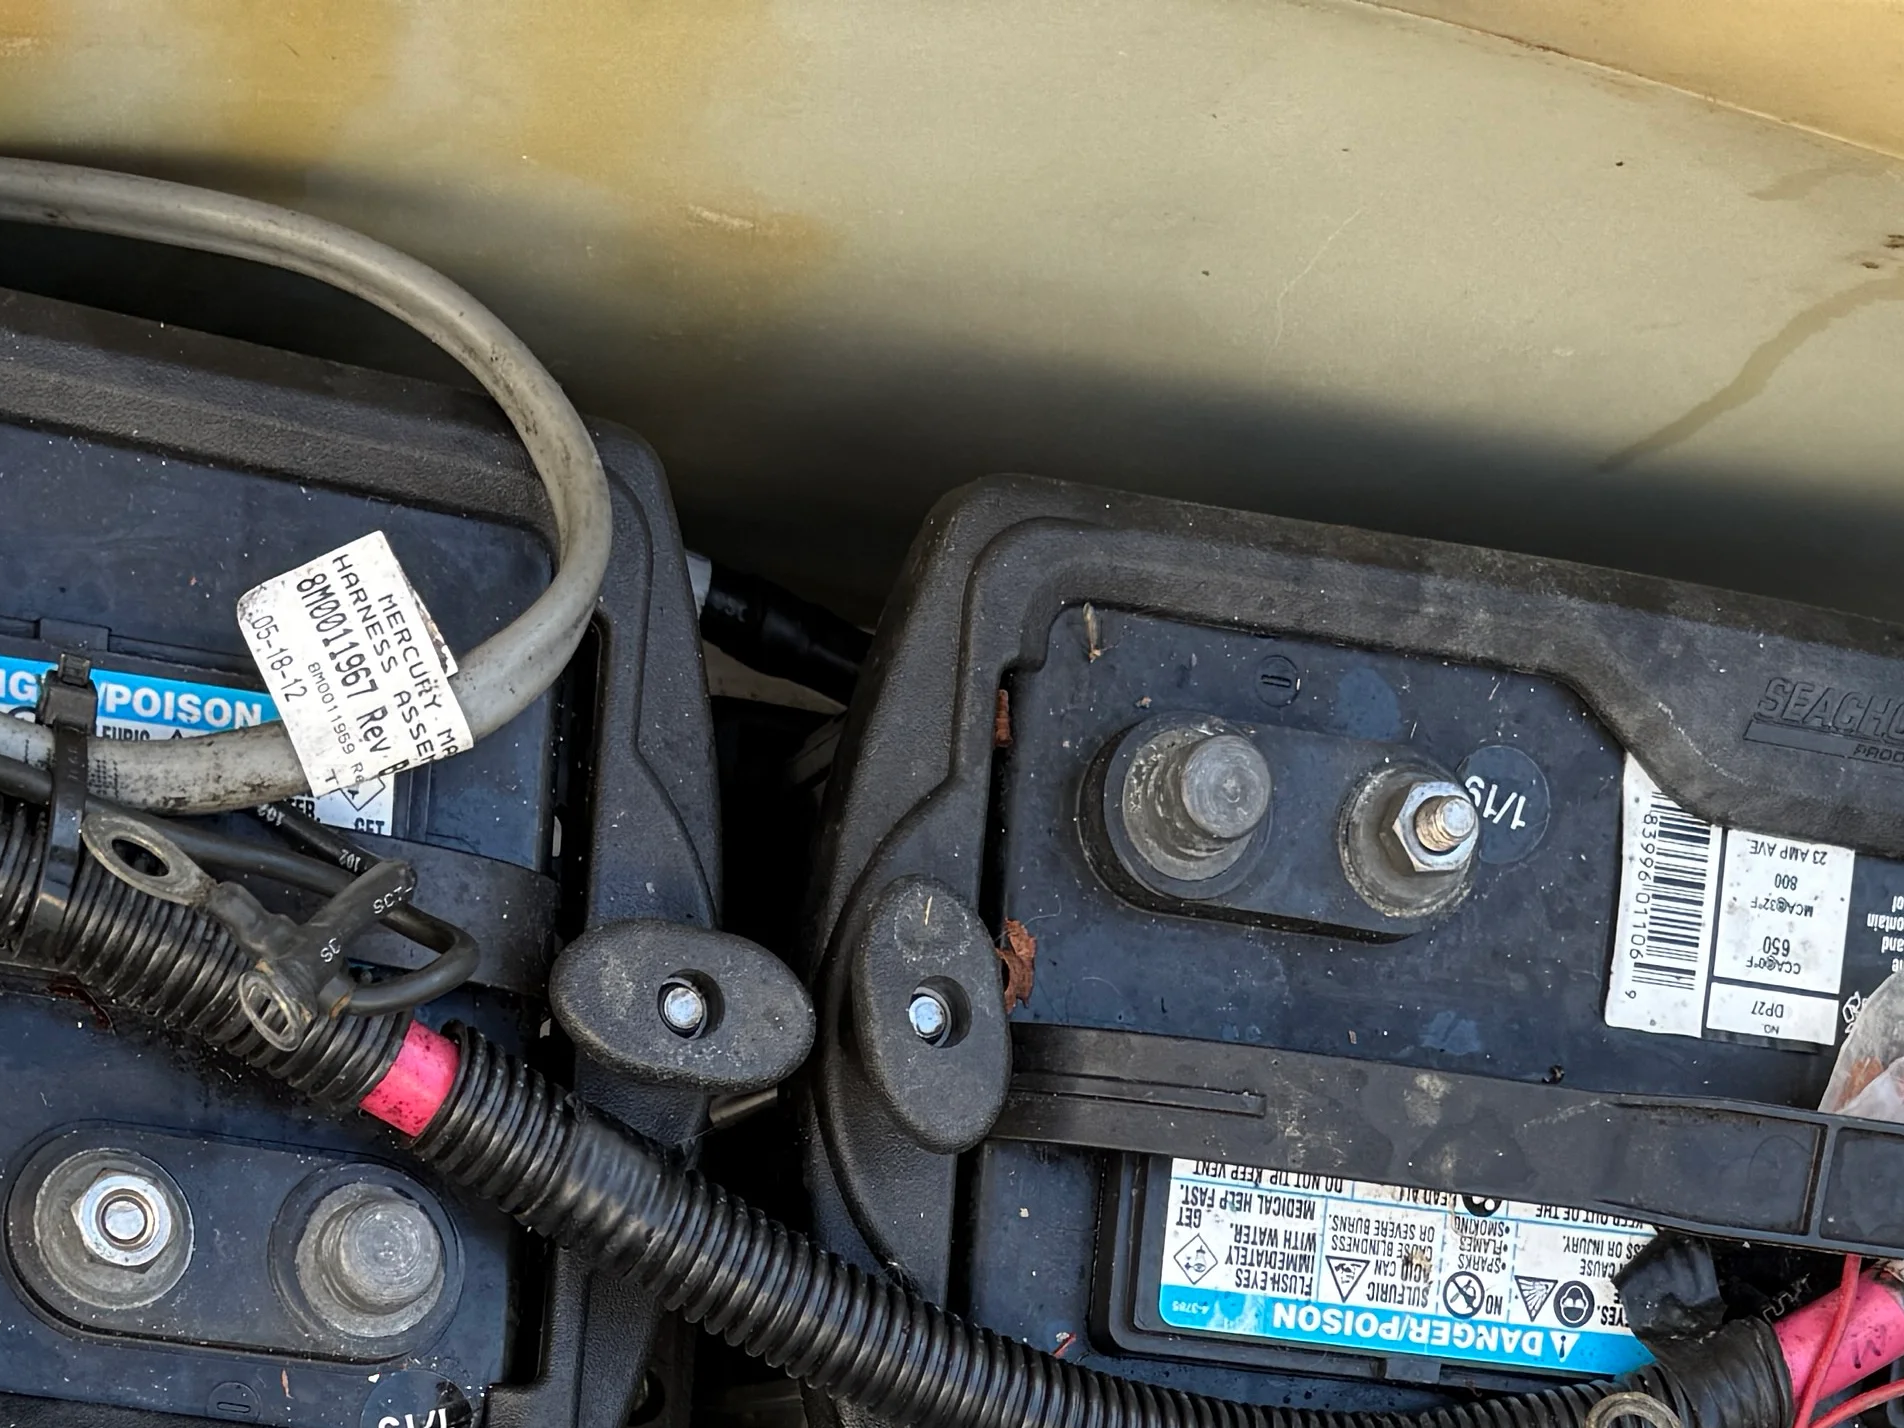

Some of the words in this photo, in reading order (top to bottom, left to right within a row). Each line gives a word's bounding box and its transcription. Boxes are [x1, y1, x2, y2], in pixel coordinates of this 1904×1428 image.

[333, 553, 399, 674] HARNESS
[297, 572, 379, 699] 8M0011967
[252, 614, 308, 703] 05-18-12
[379, 593, 442, 710] MERCURY
[1780, 844, 1810, 863] AMP
[1811, 849, 1829, 866] 23
[1774, 872, 1798, 891] 800
[1762, 935, 1791, 957] 650
[1750, 1000, 1785, 1019] DP27
[1289, 1174, 1321, 1192] NOT
[1179, 1183, 1216, 1208] FAST.
[1219, 1189, 1253, 1213] HELP
[1257, 1193, 1317, 1221] MEDICAL
[1175, 1206, 1202, 1229] GET
[1328, 1213, 1375, 1237] BURNS.
[1229, 1221, 1279, 1248] WATER.
[1373, 1219, 1417, 1241] SEVERE
[1418, 1225, 1436, 1243] OR
[1282, 1230, 1318, 1254] WITH
[1330, 1233, 1395, 1258] BLINDNESS
[1396, 1240, 1434, 1262] CAUSE
[1562, 1234, 1606, 1256] INJURY.
[1607, 1242, 1623, 1258] OR
[1224, 1244, 1316, 1275] IMMEDIATELY
[1373, 1258, 1396, 1278] CAN
[1579, 1257, 1615, 1279] CAUSE
[1366, 1281, 1430, 1309] SULFURIC
[1485, 1294, 1504, 1316] NO
[1272, 1300, 1546, 1358] DANGER/POISON
